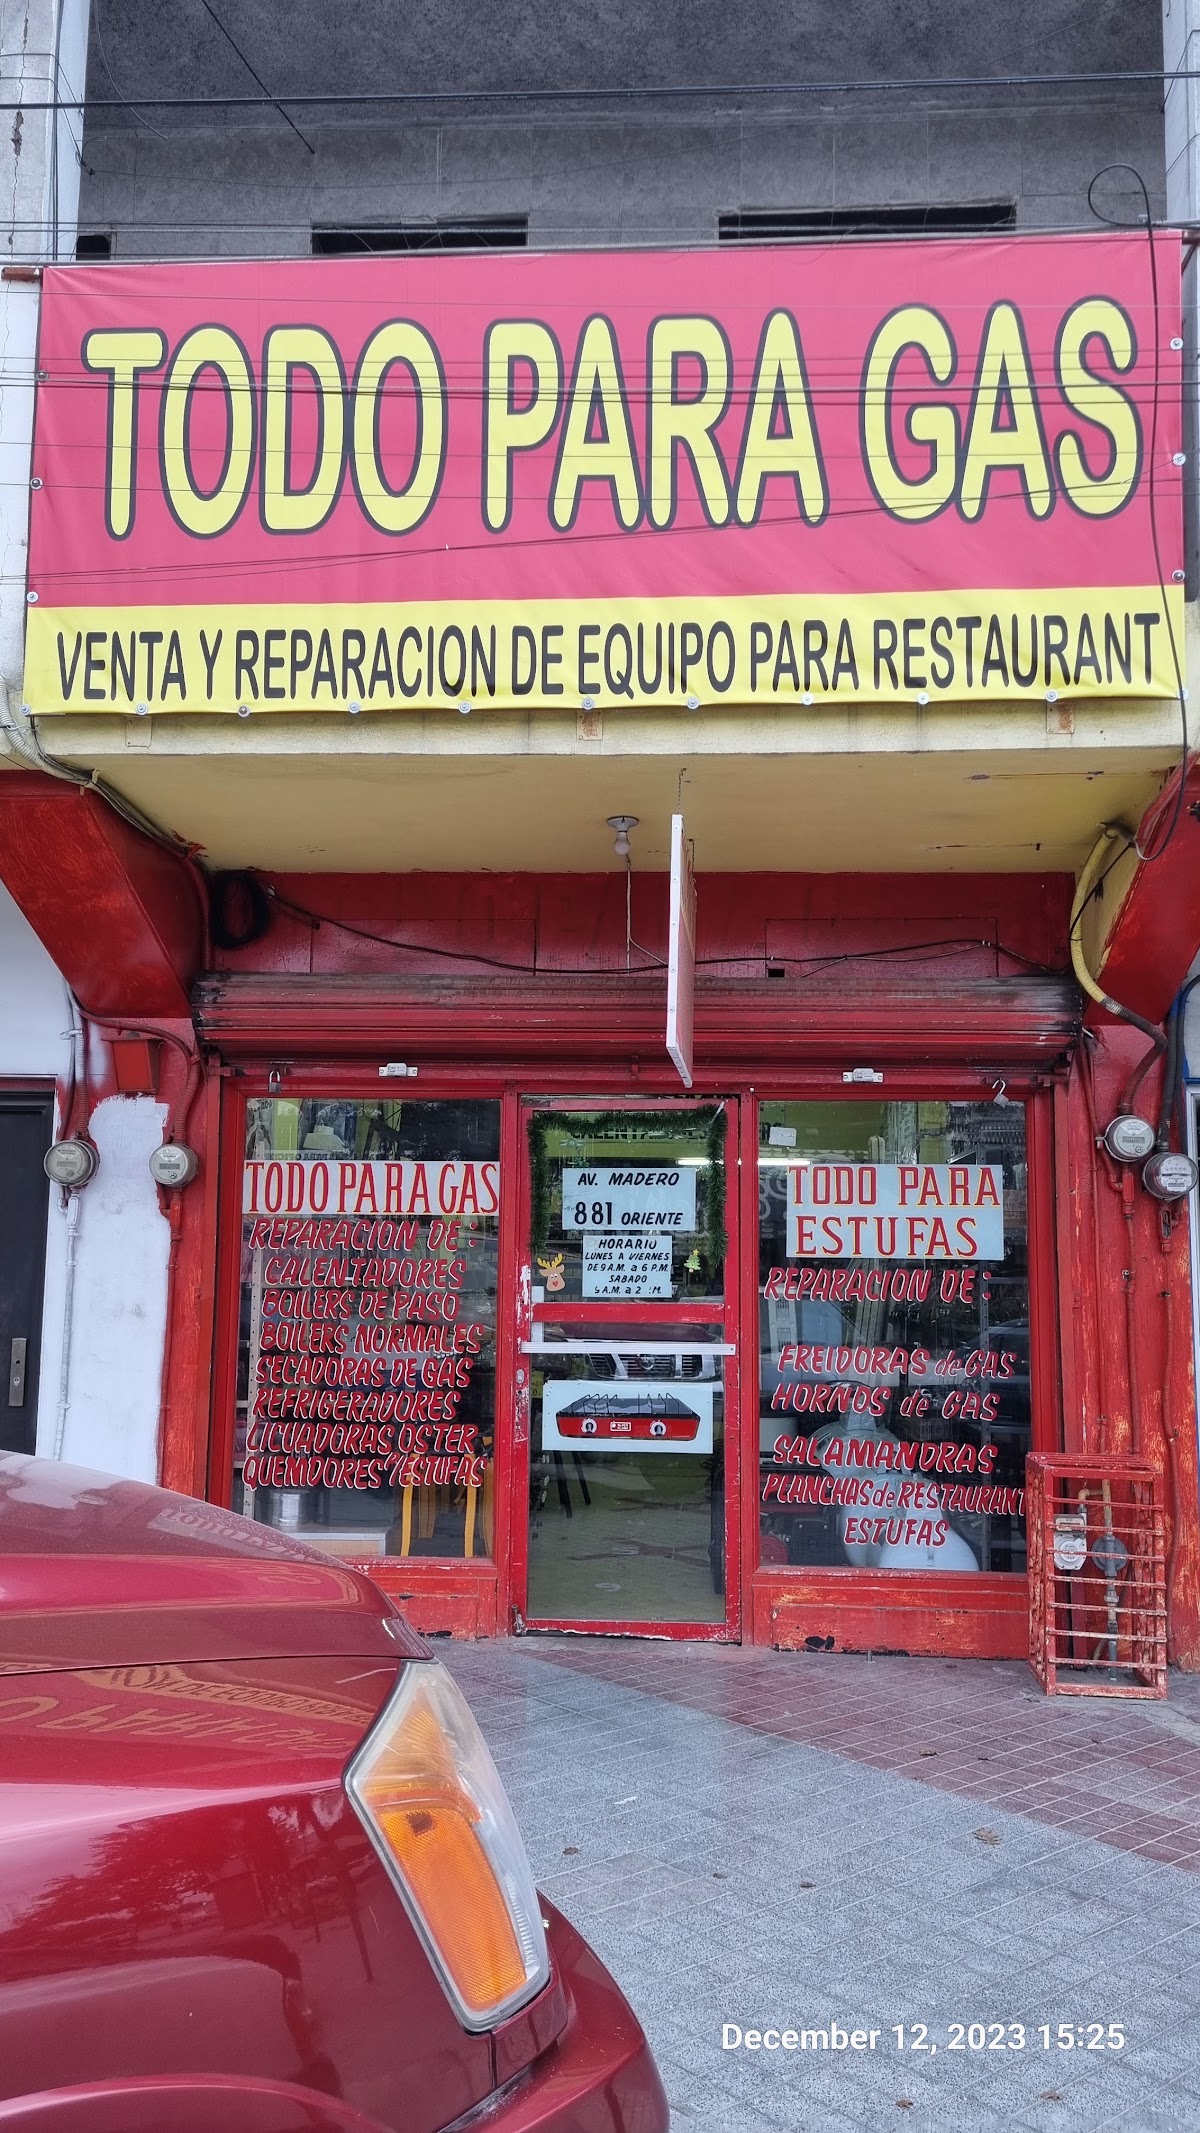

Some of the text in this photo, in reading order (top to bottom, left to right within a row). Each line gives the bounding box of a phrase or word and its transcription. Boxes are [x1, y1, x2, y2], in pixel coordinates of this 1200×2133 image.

[81, 294, 1144, 541] TODO PARA GAS
[56, 611, 1161, 701] VENTA Y REPARACION DE EQUIPO PARA RESTAURANT
[245, 1162, 499, 1214] TODO PARA GAS
[577, 1172, 680, 1187] AV. MADERO
[788, 1166, 1001, 1207] TODO PARA
[574, 1202, 683, 1226] 881 ORIENTE
[248, 1218, 420, 1252] REPARACION
[598, 1238, 657, 1250] HORARIO
[795, 1215, 978, 1257] ESTUFAS
[264, 1256, 468, 1289] CALENTADORES
[585, 1252, 670, 1261] LUNES A VIERNES
[587, 1263, 599, 1271] DE
[607, 1263, 625, 1272] A.M.
[641, 1263, 648, 1271] 6
[651, 1263, 669, 1272] P.M.
[609, 1274, 648, 1283] SABADO
[635, 1286, 642, 1294] 2
[763, 1267, 932, 1302] REPARACION
[261, 1289, 460, 1321] BOILERS DE PASO
[259, 1321, 485, 1355] BOILERS NORMALES
[254, 1355, 474, 1388] SECADORAS DE GAS
[777, 1344, 1017, 1379] FREIDORAS de GAS
[251, 1388, 462, 1423] REFRIGERADORES
[770, 1383, 1001, 1421] HORNOS de GAS
[246, 1421, 480, 1455] LICUADORAS OSTER
[772, 1434, 999, 1474] SALAMANDRAS
[761, 1473, 1026, 1517] PLANCHAS de RESTAURANT
[843, 1517, 950, 1548] ESTUFAS
